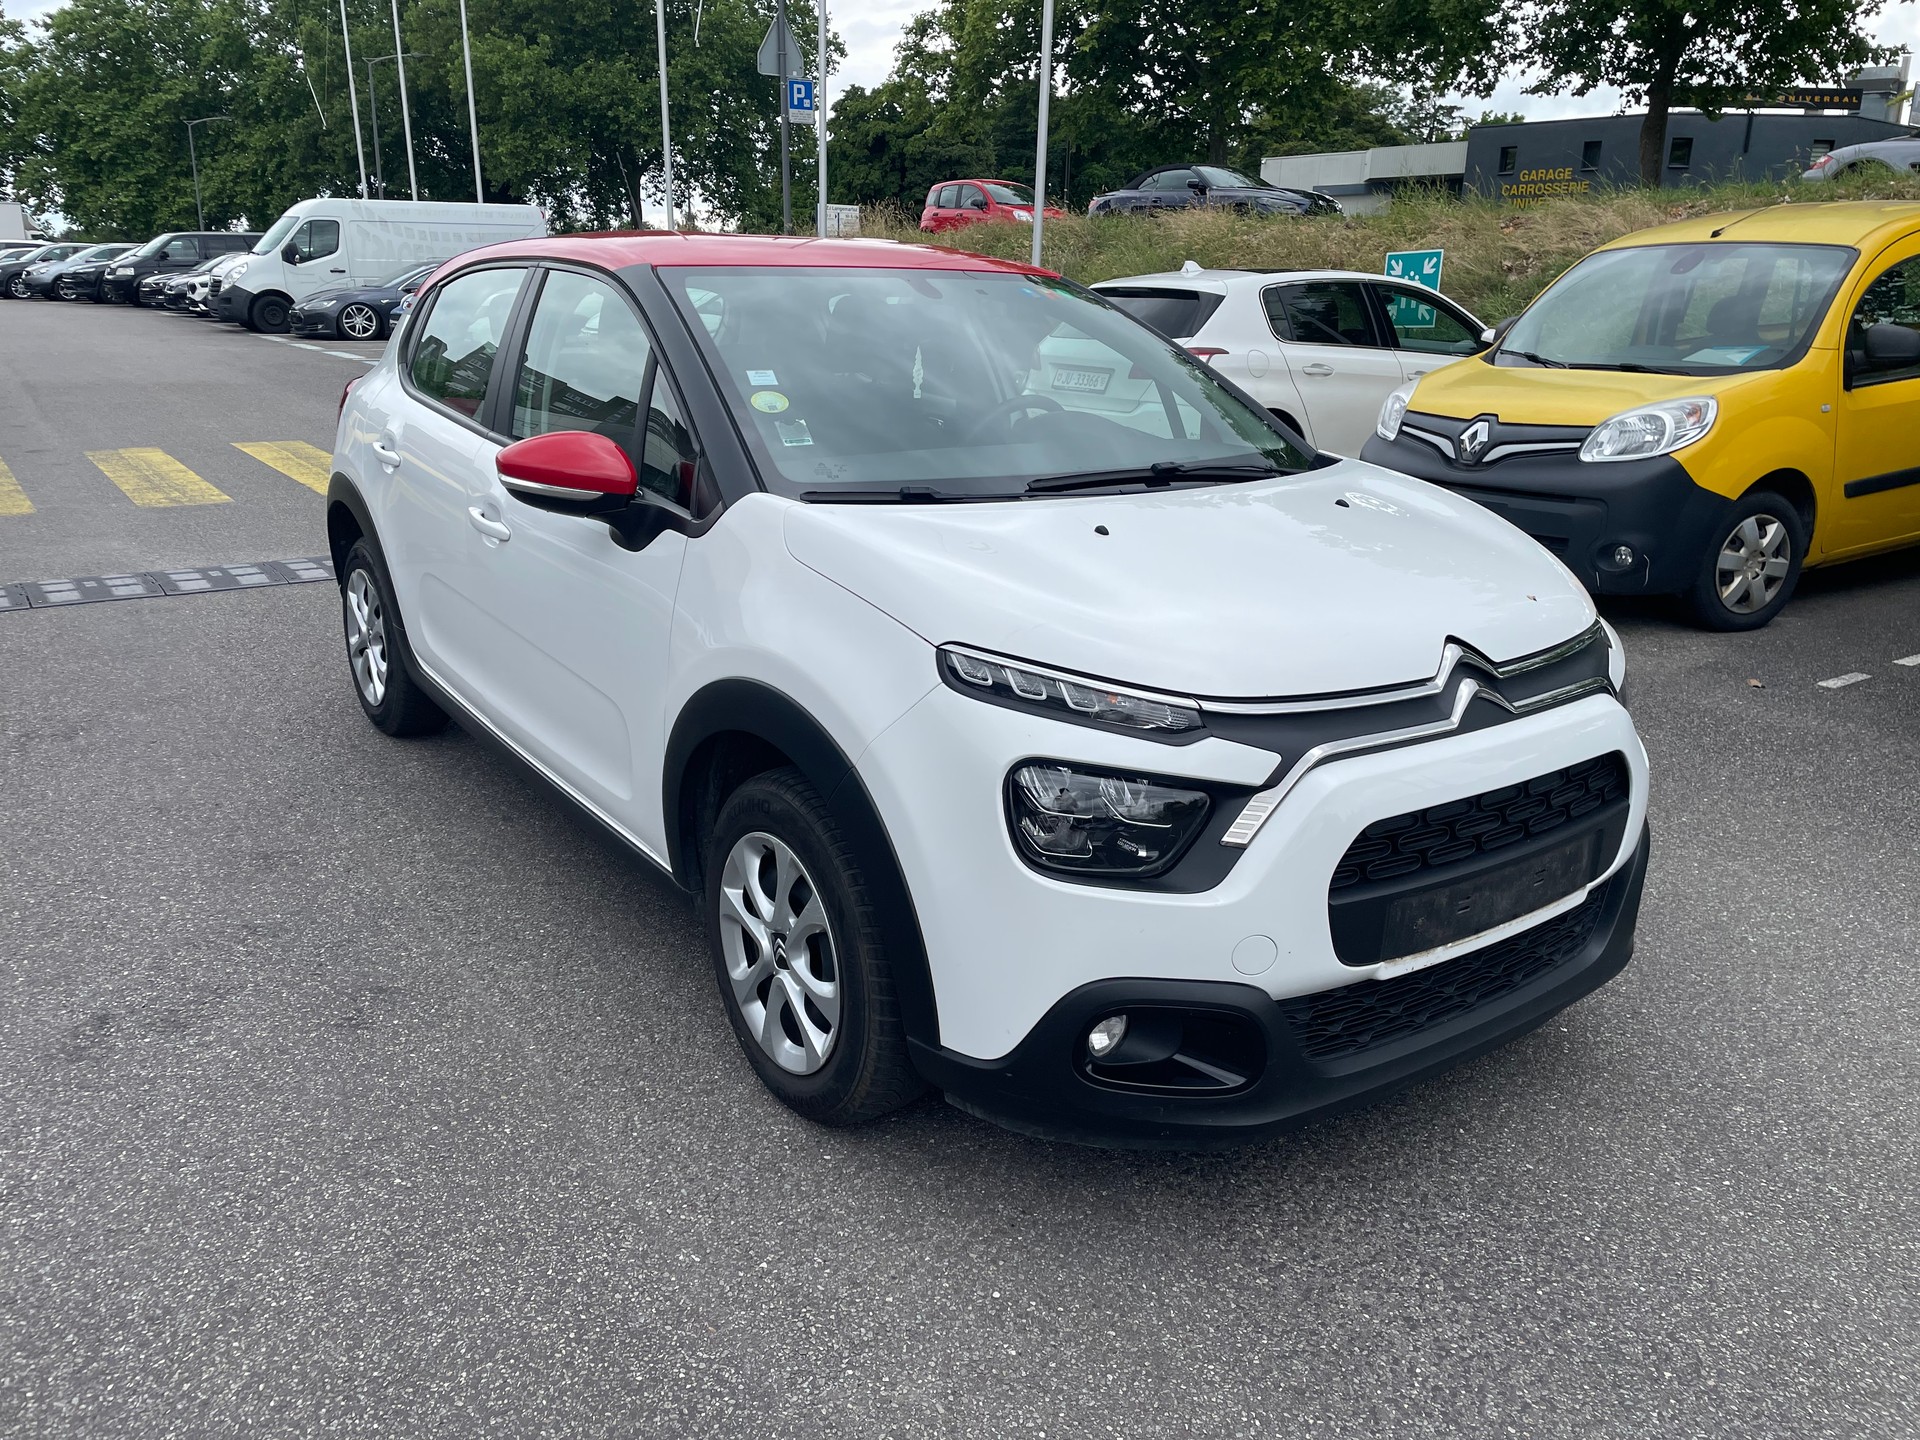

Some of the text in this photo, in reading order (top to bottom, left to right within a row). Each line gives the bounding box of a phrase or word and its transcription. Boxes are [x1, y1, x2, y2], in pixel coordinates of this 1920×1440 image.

[793, 84, 805, 105] P
[1778, 95, 1859, 103] UNIVERSAL
[1520, 168, 1573, 181] GARAGE
[1501, 181, 1590, 196] CARROSSERIE
